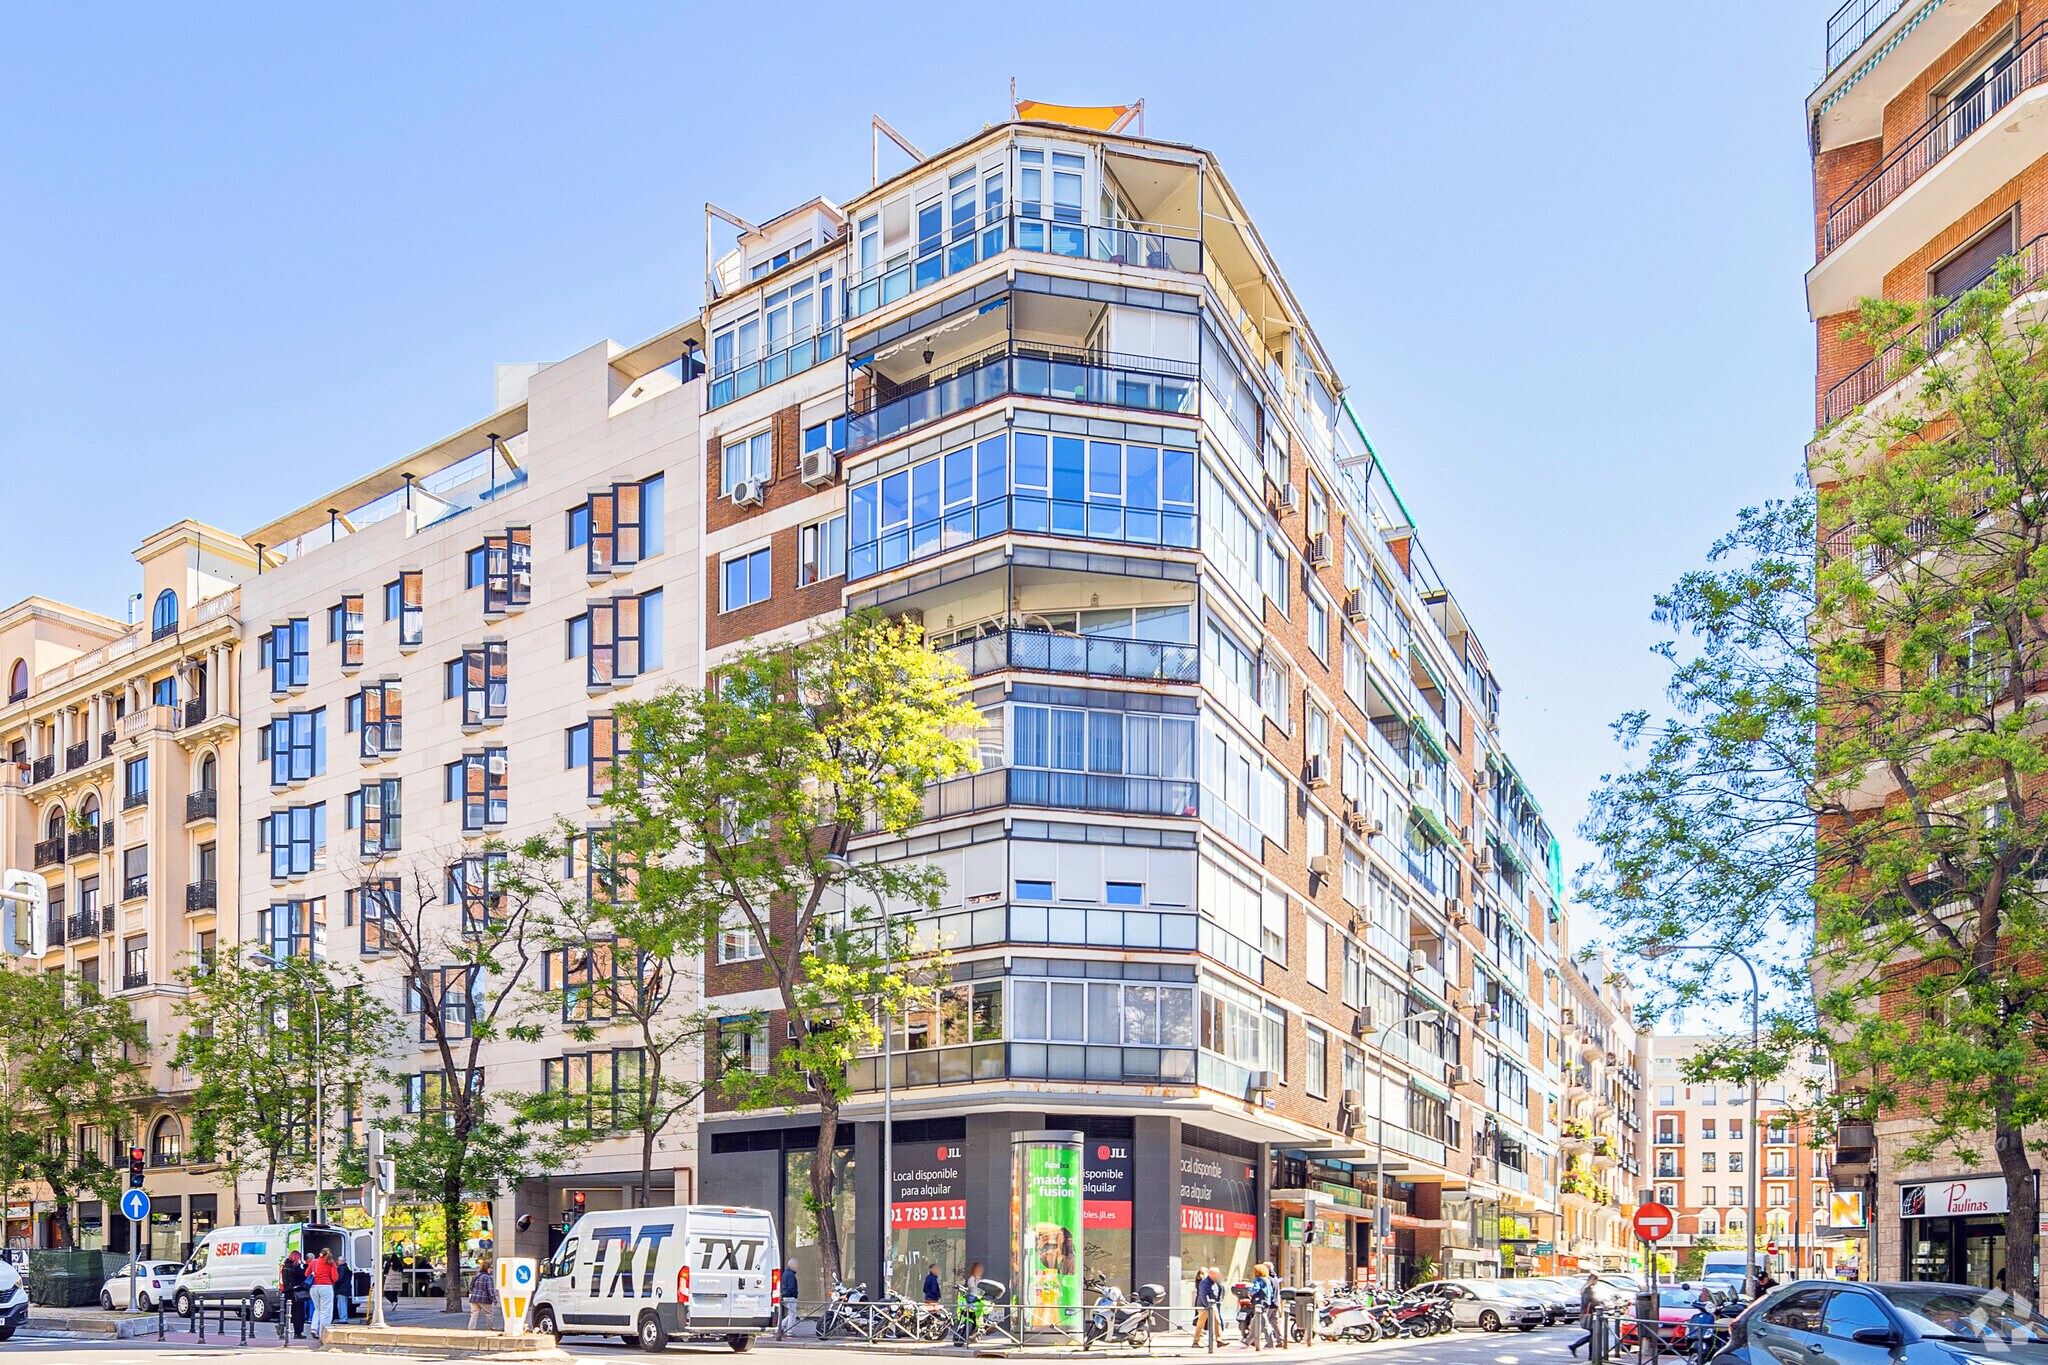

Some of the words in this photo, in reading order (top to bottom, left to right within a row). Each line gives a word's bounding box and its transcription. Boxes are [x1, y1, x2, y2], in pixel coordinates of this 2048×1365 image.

[948, 1148, 961, 1158] JLL
[1110, 1148, 1127, 1158] JLL
[893, 1170, 914, 1181] Local
[916, 1168, 958, 1182] disponible
[1082, 1169, 1124, 1179] isponible
[1181, 1157, 1193, 1173] ocal
[1193, 1158, 1222, 1179] disponible
[1033, 1175, 1066, 1186] made
[1069, 1175, 1078, 1186] of
[902, 1187, 919, 1198] para
[921, 1184, 952, 1197] alquilar
[1040, 1186, 1074, 1197] fusion
[1083, 1183, 1117, 1194] alquilar
[1181, 1184, 1191, 1198] ara
[1191, 1182, 1213, 1203] alquilar
[1943, 1183, 1988, 1213] Paulinas
[905, 1207, 928, 1221] 789
[931, 1206, 947, 1220] 11
[950, 1205, 966, 1219] 11
[1083, 1211, 1116, 1220] bles.jll.es
[1188, 1210, 1204, 1230] 789
[1204, 1211, 1214, 1231] 11
[1215, 1213, 1225, 1232] 11
[216, 1242, 239, 1257] SEUR
[700, 1238, 764, 1270] TXT
[590, 1224, 674, 1298] TXT
